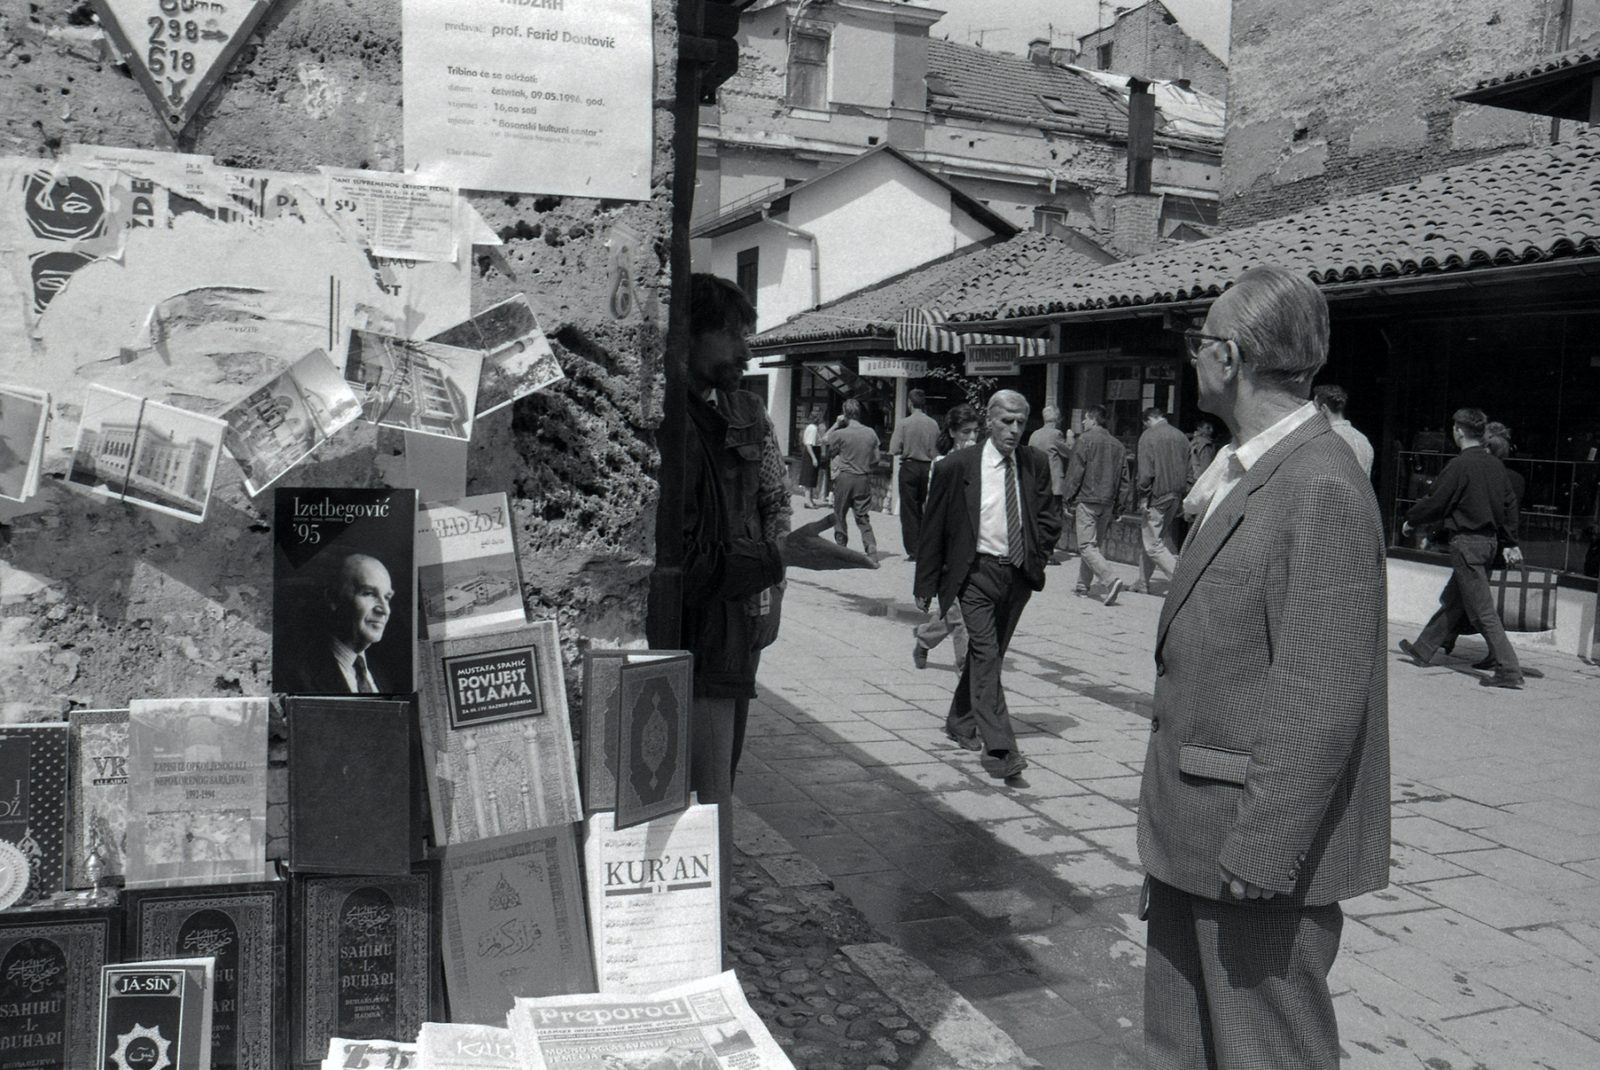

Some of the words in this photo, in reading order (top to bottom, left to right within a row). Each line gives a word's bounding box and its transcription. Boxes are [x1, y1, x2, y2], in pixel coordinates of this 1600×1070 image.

[491, 24, 522, 38] prof.
[527, 26, 558, 42] Ferid
[447, 65, 478, 78] Tribina
[294, 496, 391, 524] Izetbegović
[292, 523, 320, 544] '95
[457, 663, 496, 676] MUSTAFA
[496, 658, 526, 670] SPAHIĆ
[458, 667, 527, 691] POVIJEST
[460, 681, 532, 706] ISLAMA
[605, 853, 711, 886] KUR'AN
[341, 943, 392, 958] SAHIHU
[120, 976, 171, 993] JĀ-SĪN
[343, 973, 394, 989] BUHARI
[0, 1000, 61, 1017] SAHIHU
[536, 1001, 683, 1026] Preporod
[0, 1031, 62, 1050] BUHARI
